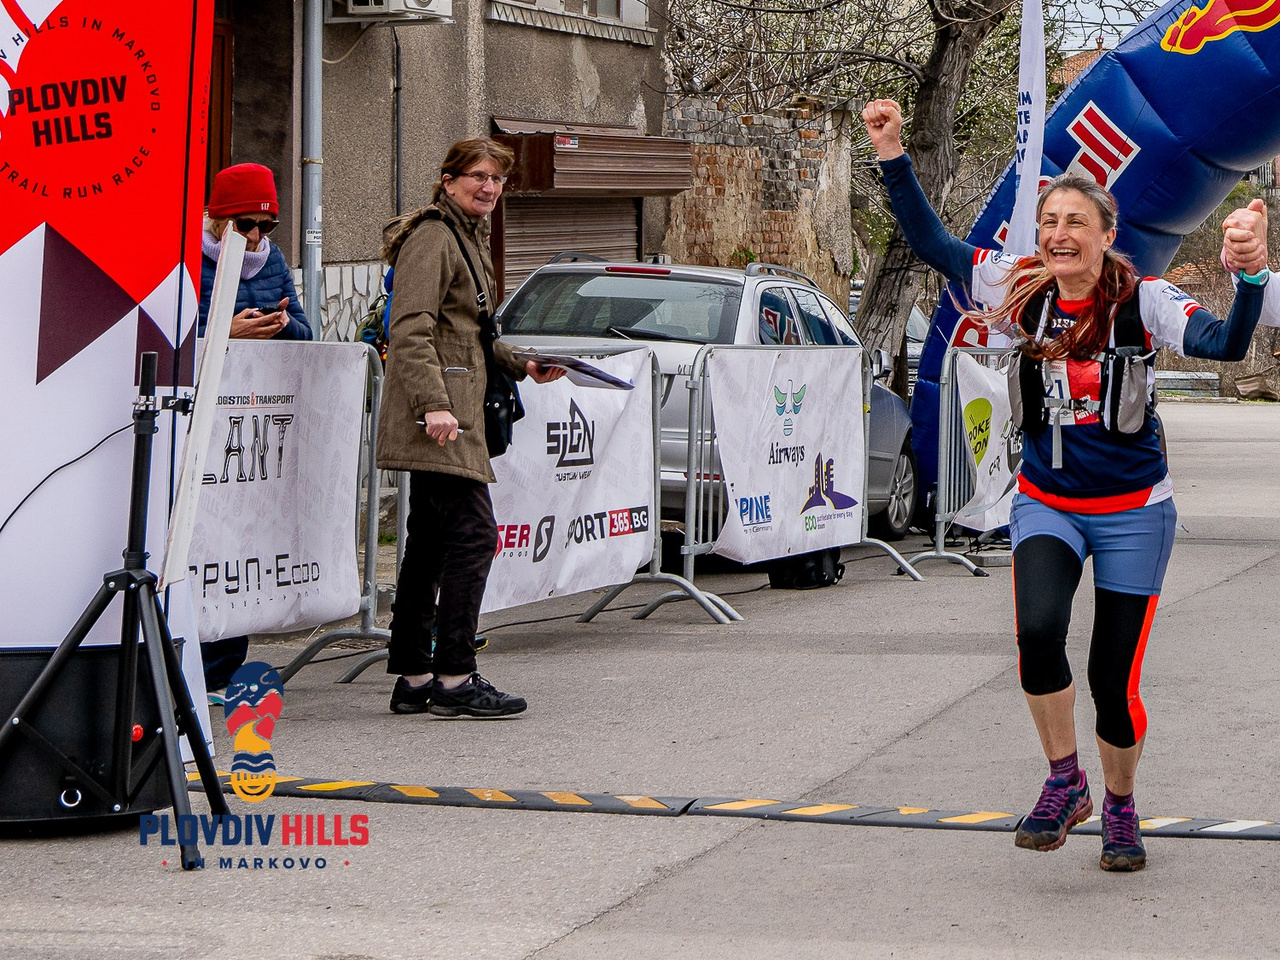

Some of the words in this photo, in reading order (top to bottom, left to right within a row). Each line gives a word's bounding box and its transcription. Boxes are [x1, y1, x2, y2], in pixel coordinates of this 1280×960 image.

[12, 16, 69, 46] HILLS
[82, 17, 102, 31] IN
[112, 28, 160, 110] MARKOVO
[8, 75, 127, 116] PLOVDIV
[32, 112, 112, 147] HILLS
[0, 161, 49, 197] TRAIL
[63, 182, 103, 199] RUN
[112, 146, 150, 186] RACE
[768, 442, 805, 467] Airways
[804, 515, 817, 531] ECO
